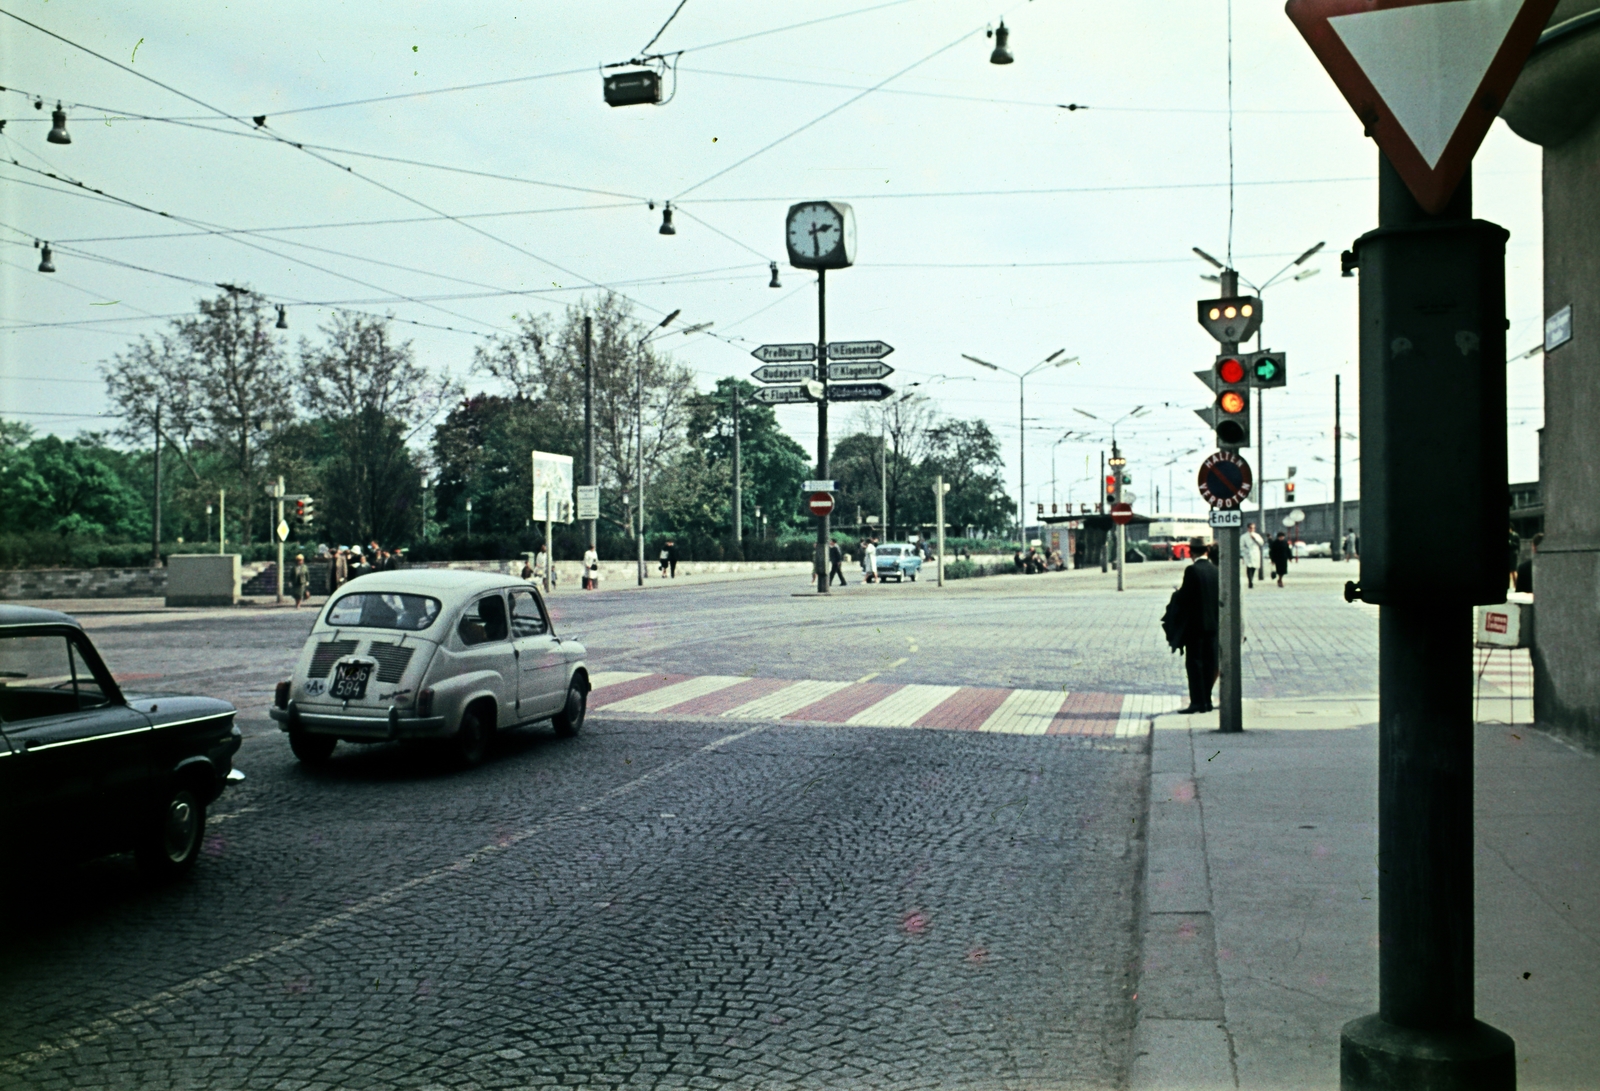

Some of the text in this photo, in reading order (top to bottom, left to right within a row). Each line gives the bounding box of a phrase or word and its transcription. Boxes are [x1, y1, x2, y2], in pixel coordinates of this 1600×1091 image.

[1205, 451, 1243, 468] HALTEN
[1199, 482, 1250, 508] VERBOTEN
[1212, 512, 1238, 524] Ende
[336, 680, 360, 696] 584
